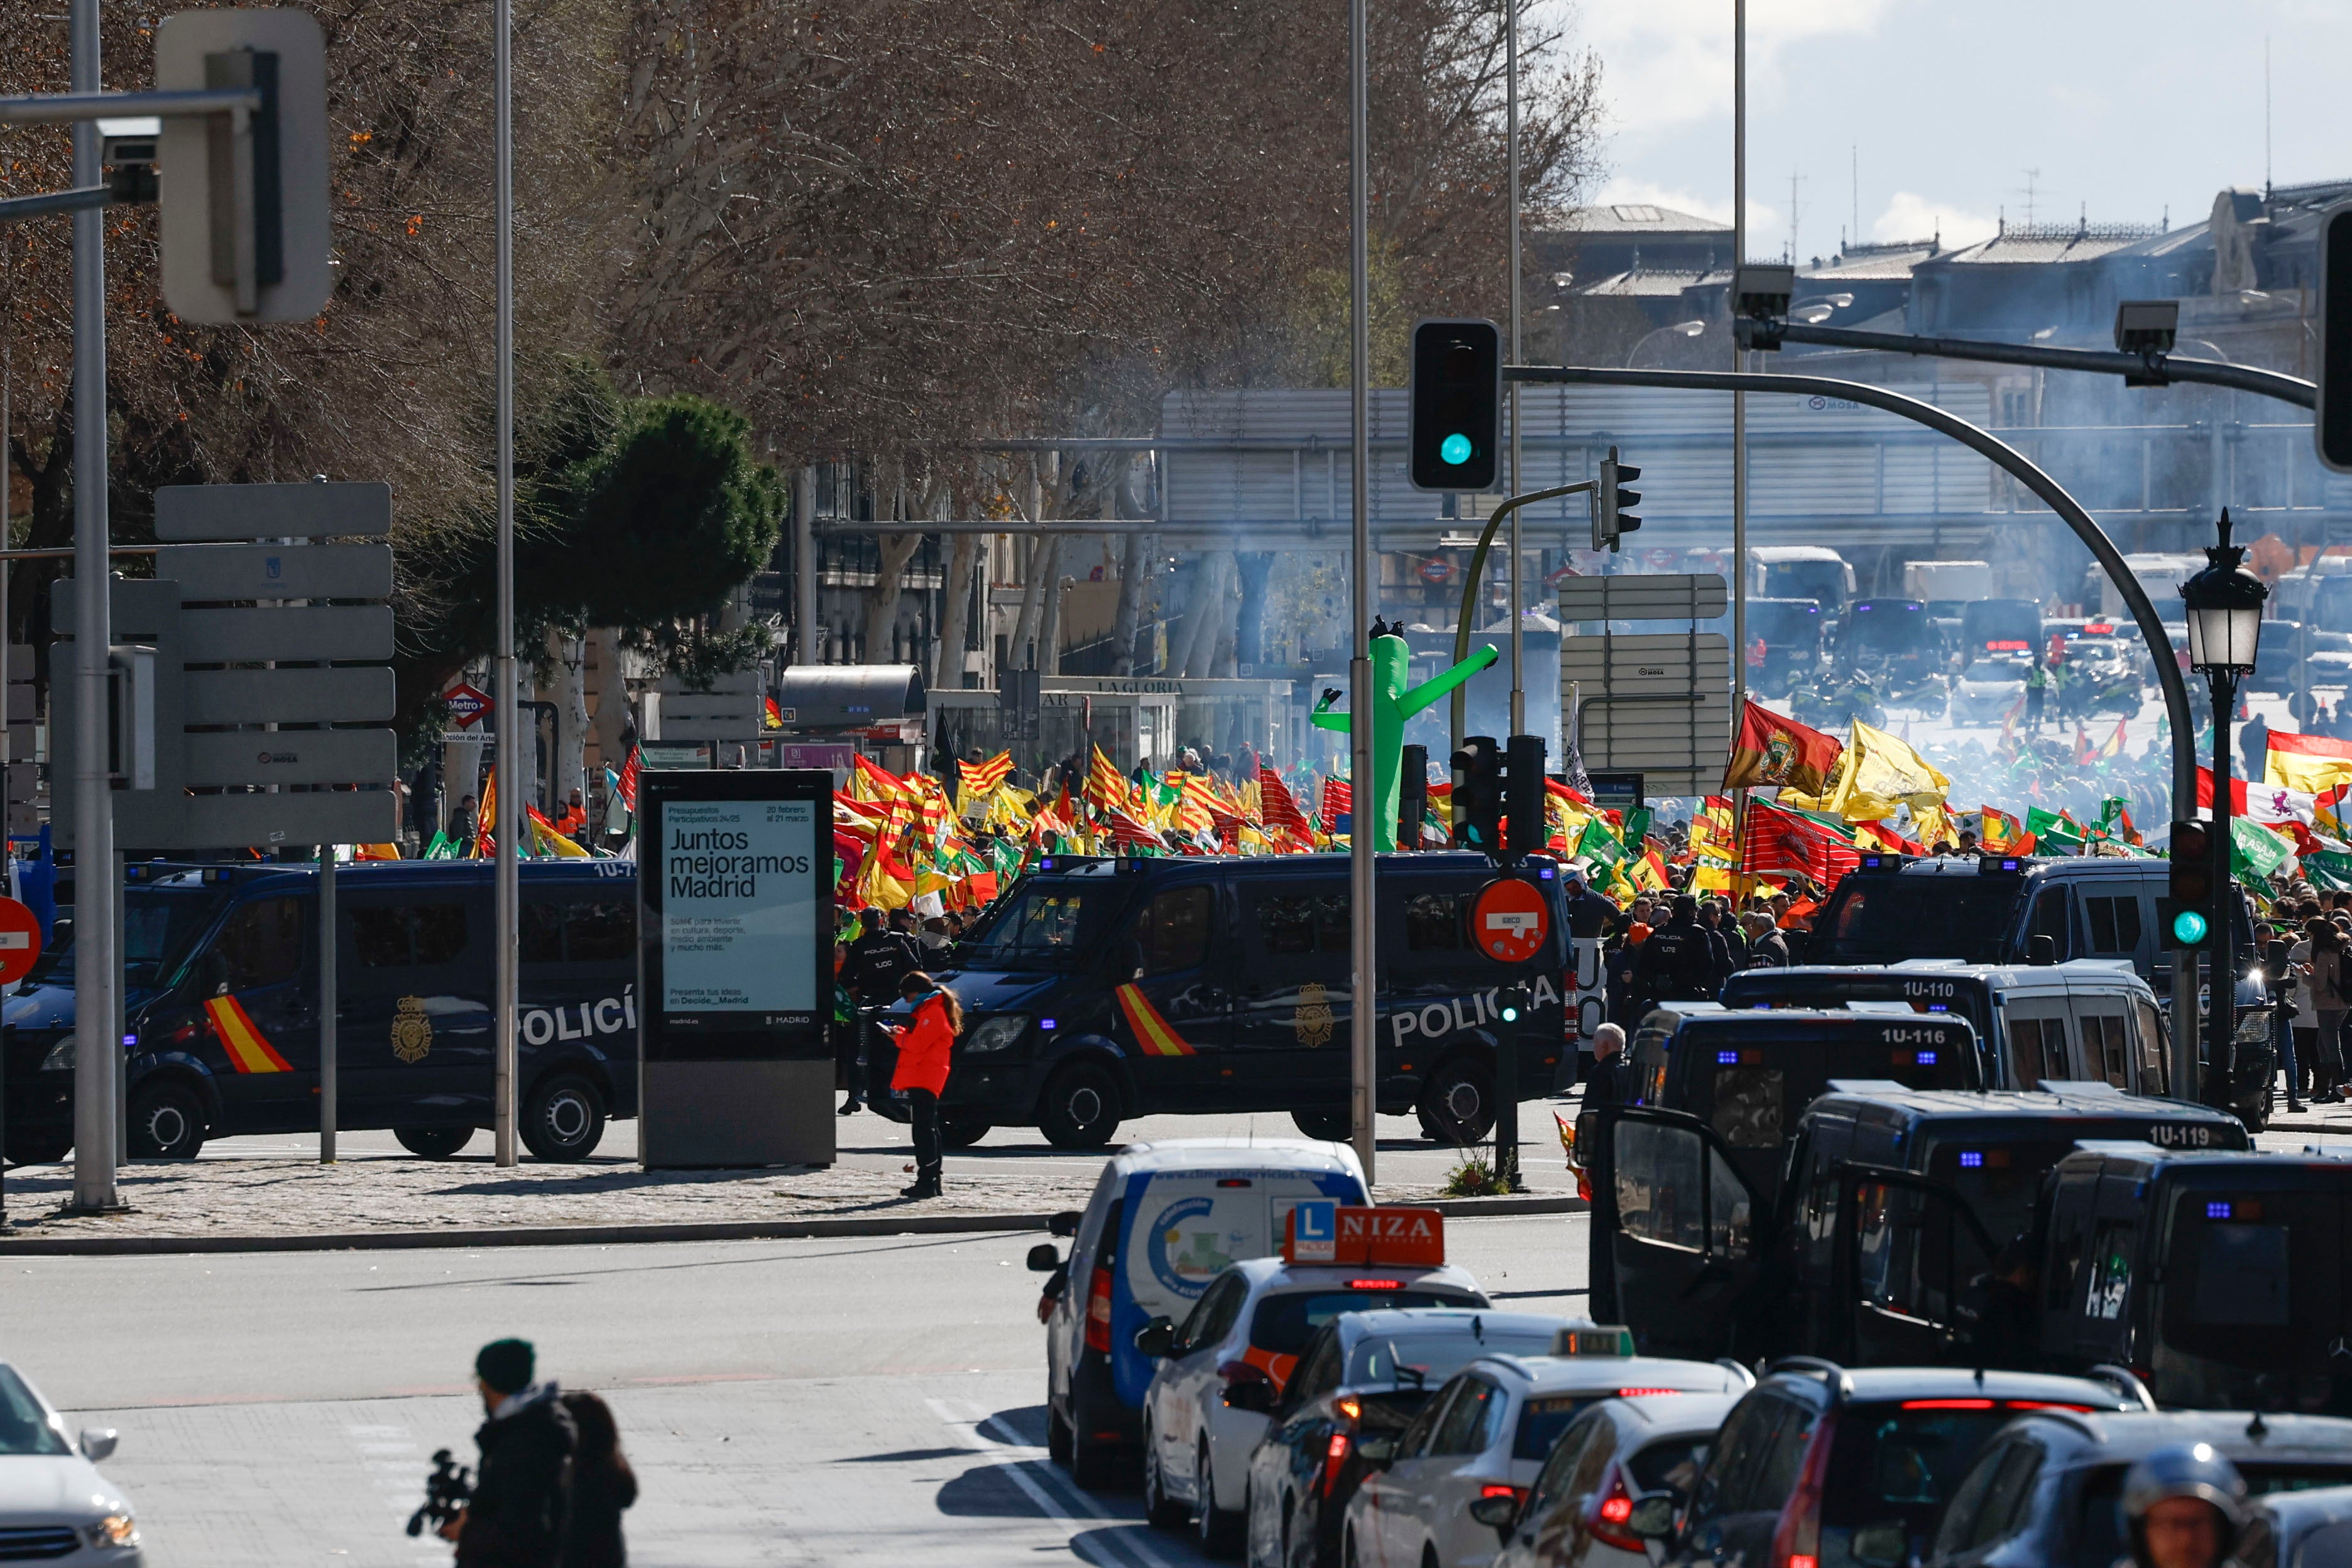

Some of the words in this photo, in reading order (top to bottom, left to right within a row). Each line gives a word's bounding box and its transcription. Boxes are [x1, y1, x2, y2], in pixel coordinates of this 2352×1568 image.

[1827, 401, 1859, 410] MOSA
[1098, 682, 1118, 693] LA
[1122, 682, 1183, 694] GLORIA
[449, 700, 478, 709] Metro
[669, 807, 719, 815] Presupuestos
[670, 828, 748, 850] Juntos
[2247, 837, 2277, 860] ASAJA
[670, 851, 809, 879] mejoramos
[670, 874, 755, 898] Madrid
[864, 946, 894, 956] POLICIA
[1903, 981, 1954, 998] 1U-110
[1882, 1029, 1945, 1044] 1U-116
[2150, 1126, 2210, 1146] 1U-119
[1305, 1208, 1324, 1236] L
[1342, 1216, 1433, 1237] NIZA
